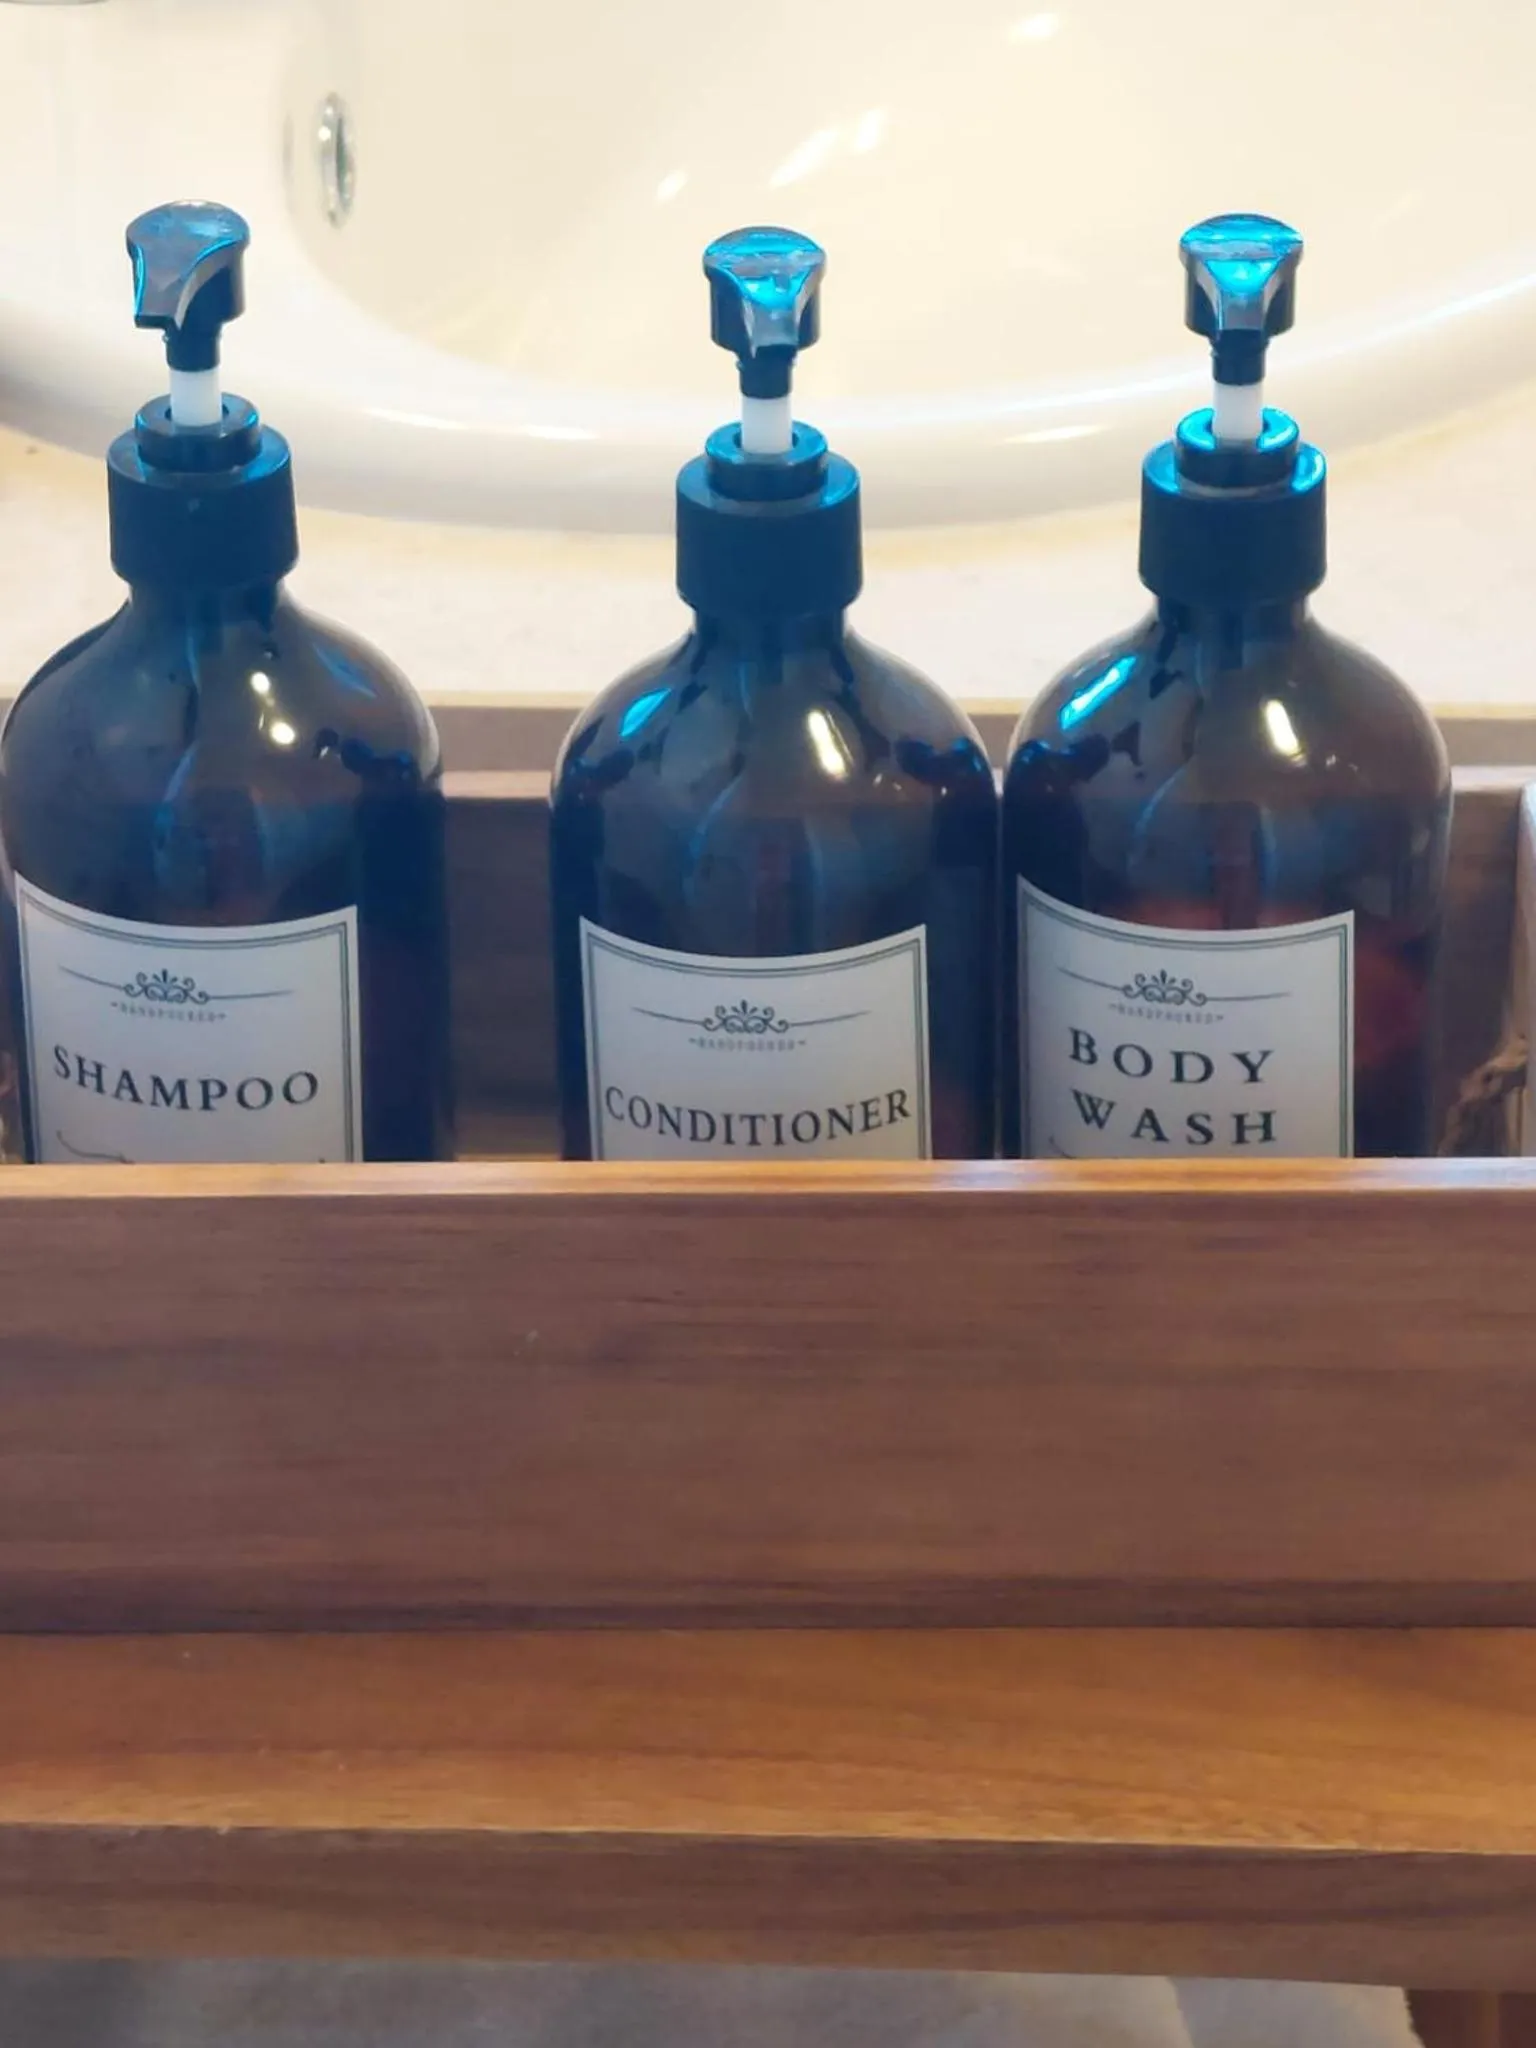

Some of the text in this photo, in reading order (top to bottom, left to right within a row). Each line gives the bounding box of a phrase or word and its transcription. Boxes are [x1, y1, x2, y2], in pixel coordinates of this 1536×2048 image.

[53, 1044, 319, 1111] SHAMPOO
[1068, 1026, 1275, 1084] BODY
[605, 1086, 912, 1147] CONDITIONER
[1071, 1088, 1278, 1146] WASH
